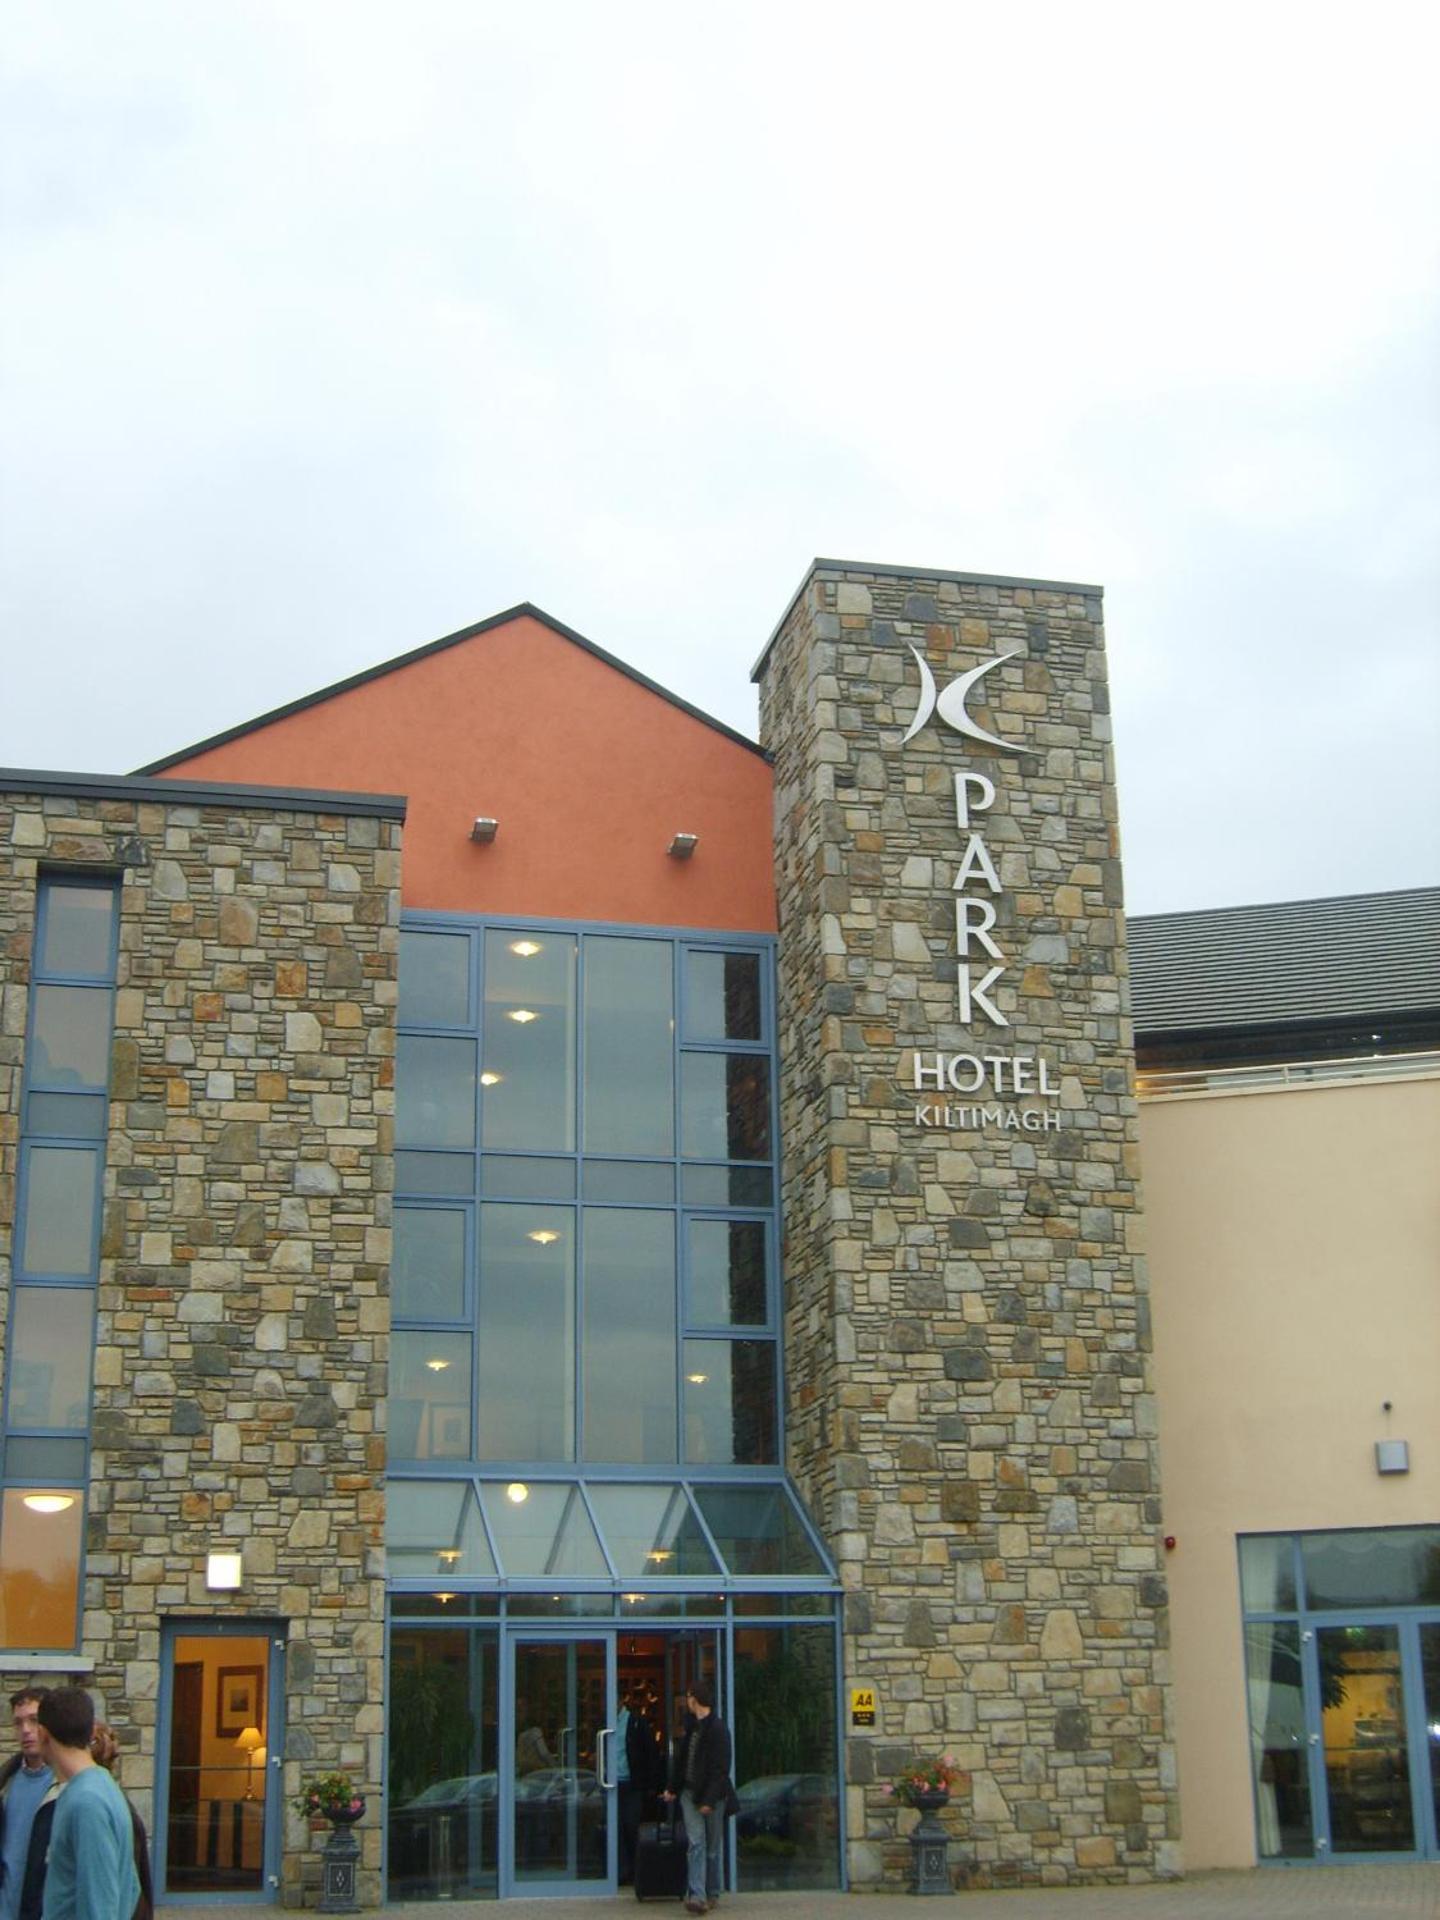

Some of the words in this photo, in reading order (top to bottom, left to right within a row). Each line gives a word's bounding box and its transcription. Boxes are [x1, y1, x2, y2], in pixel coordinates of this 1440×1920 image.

[953, 772, 1010, 1026] PARK
[913, 1052, 1061, 1096] HOTEL
[914, 1105, 1062, 1132] KILTIMAGH
